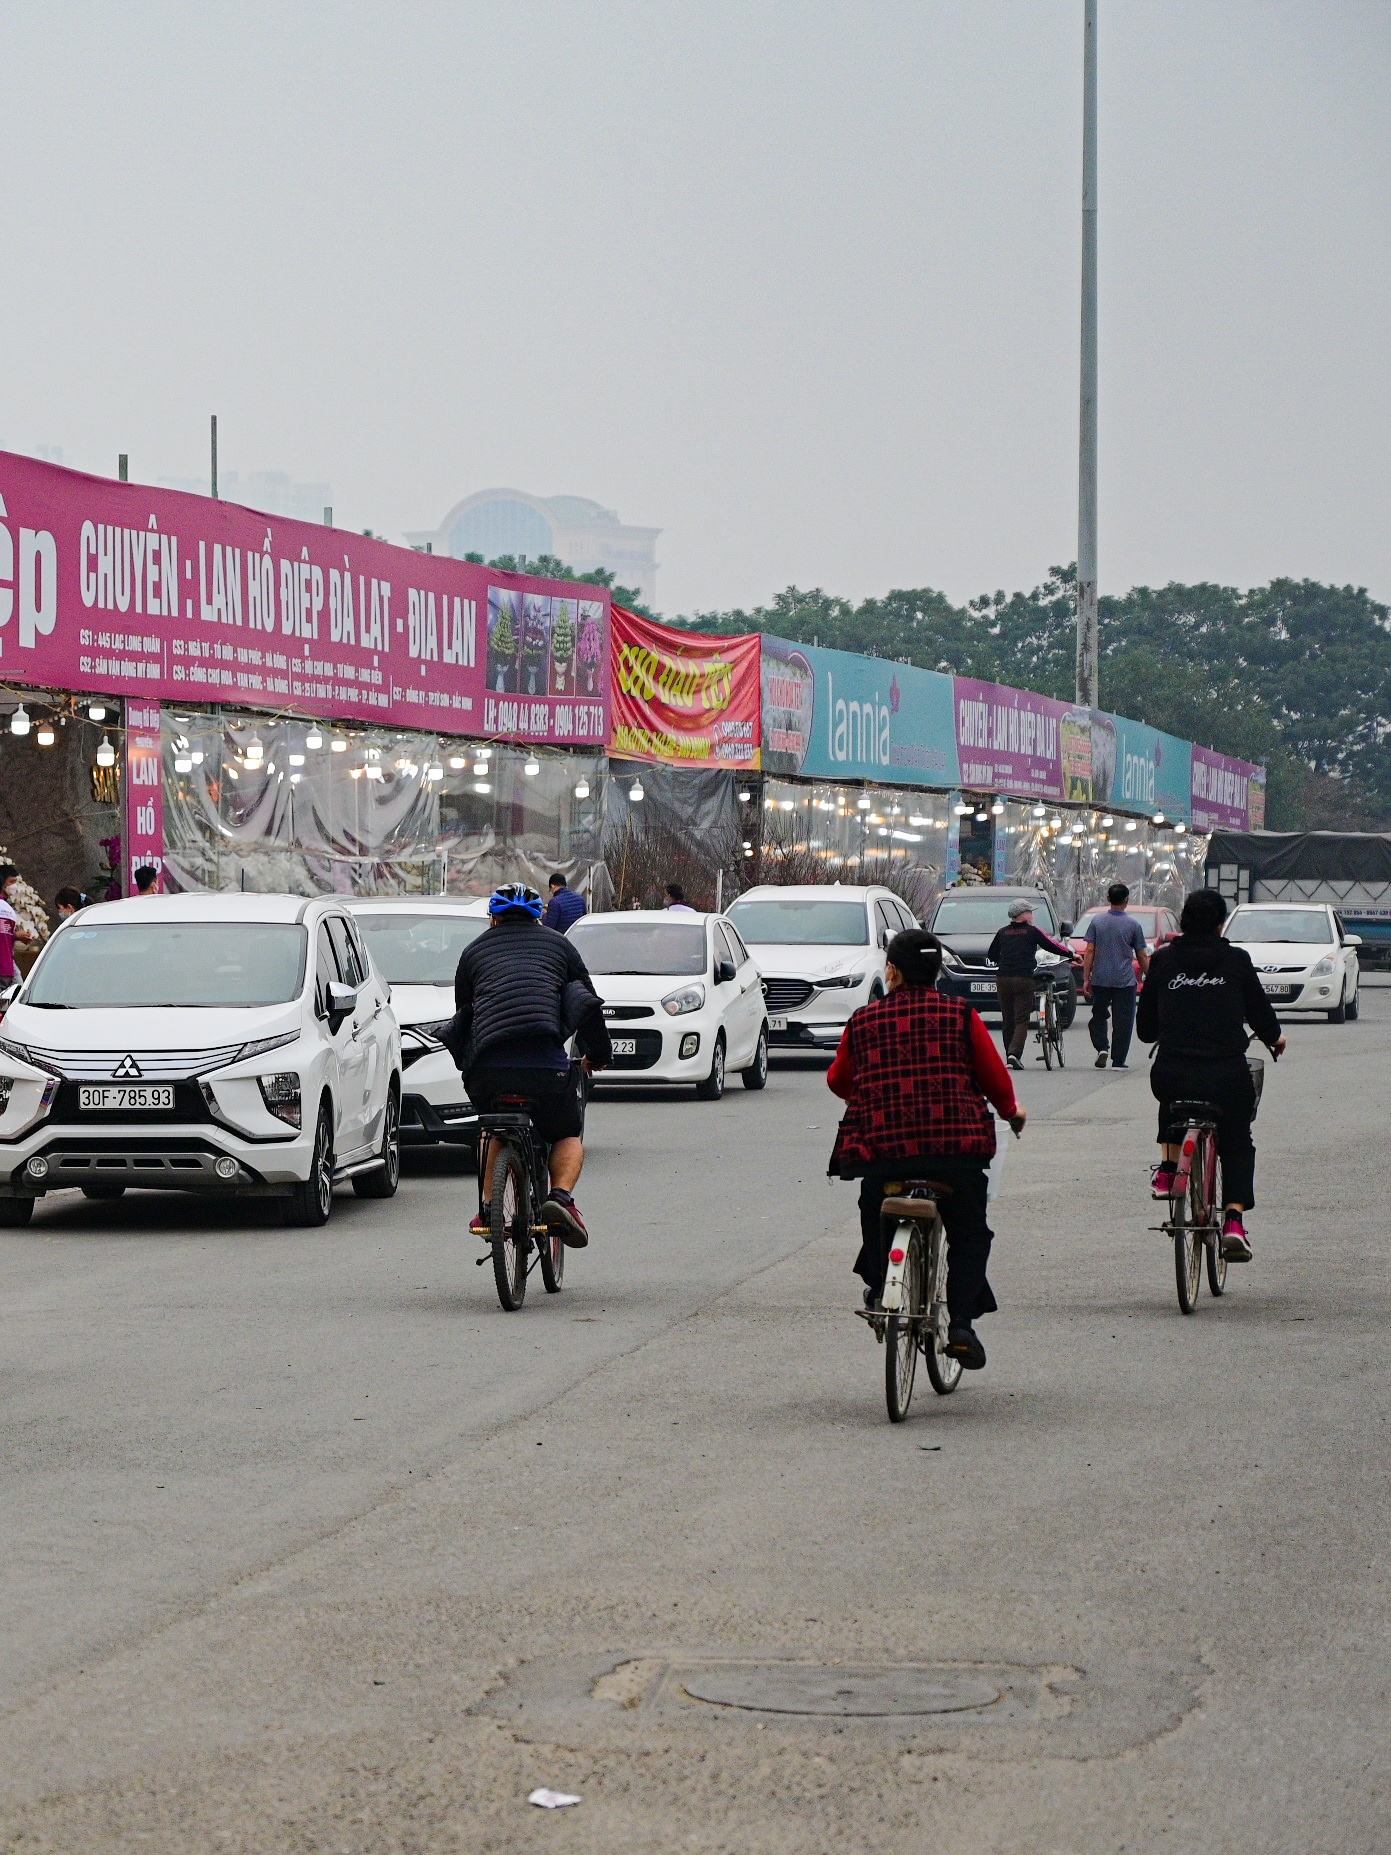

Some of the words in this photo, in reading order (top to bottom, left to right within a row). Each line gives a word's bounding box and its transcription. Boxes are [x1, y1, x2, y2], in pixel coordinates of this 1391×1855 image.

[80, 514, 178, 617] CHUYÊN
[198, 540, 243, 626] LAN
[247, 528, 275, 633] HỒ
[280, 546, 324, 656] ĐIỆP
[329, 554, 356, 645] ĐÀ
[359, 575, 391, 667] LẠT
[408, 587, 439, 676] ĐỊA
[442, 594, 477, 668] LAN
[79, 628, 93, 646] CS1
[111, 634, 124, 653] LẠC
[125, 635, 142, 651] LONG
[484, 698, 496, 731] LH:
[498, 701, 518, 732] 0948
[519, 704, 529, 735] 44
[555, 704, 573, 736] 0904
[575, 705, 589, 736] 125
[590, 705, 604, 736] 713
[828, 671, 890, 766] lannia
[132, 756, 158, 786] LAN
[1122, 733, 1154, 805] lannia
[137, 797, 155, 835] HỒ
[82, 1089, 171, 1107] 30F-785.93
